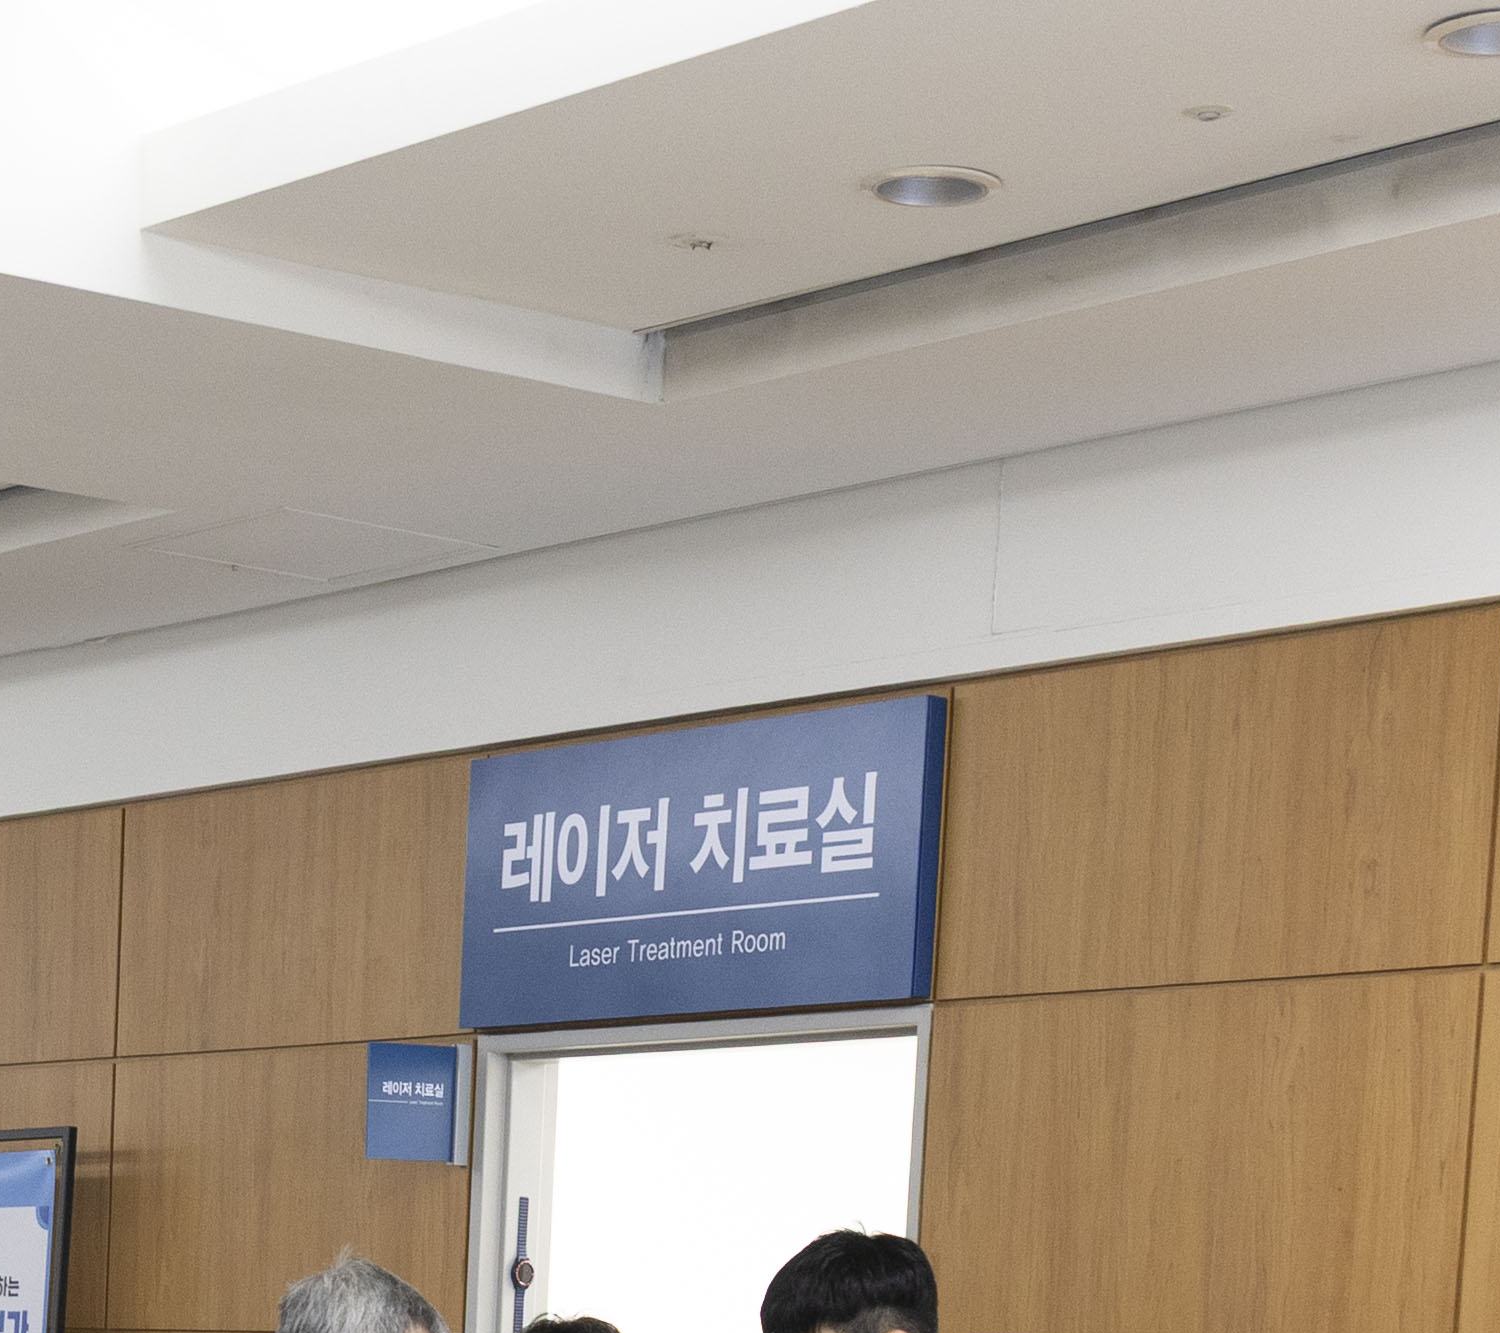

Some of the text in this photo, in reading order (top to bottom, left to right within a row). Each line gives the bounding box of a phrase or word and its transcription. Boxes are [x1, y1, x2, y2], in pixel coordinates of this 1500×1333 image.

[500, 771, 878, 903] 레이저 치료실
[569, 929, 786, 967] Laser Treatment Room
[382, 1081, 444, 1099] 레이저 치료실
